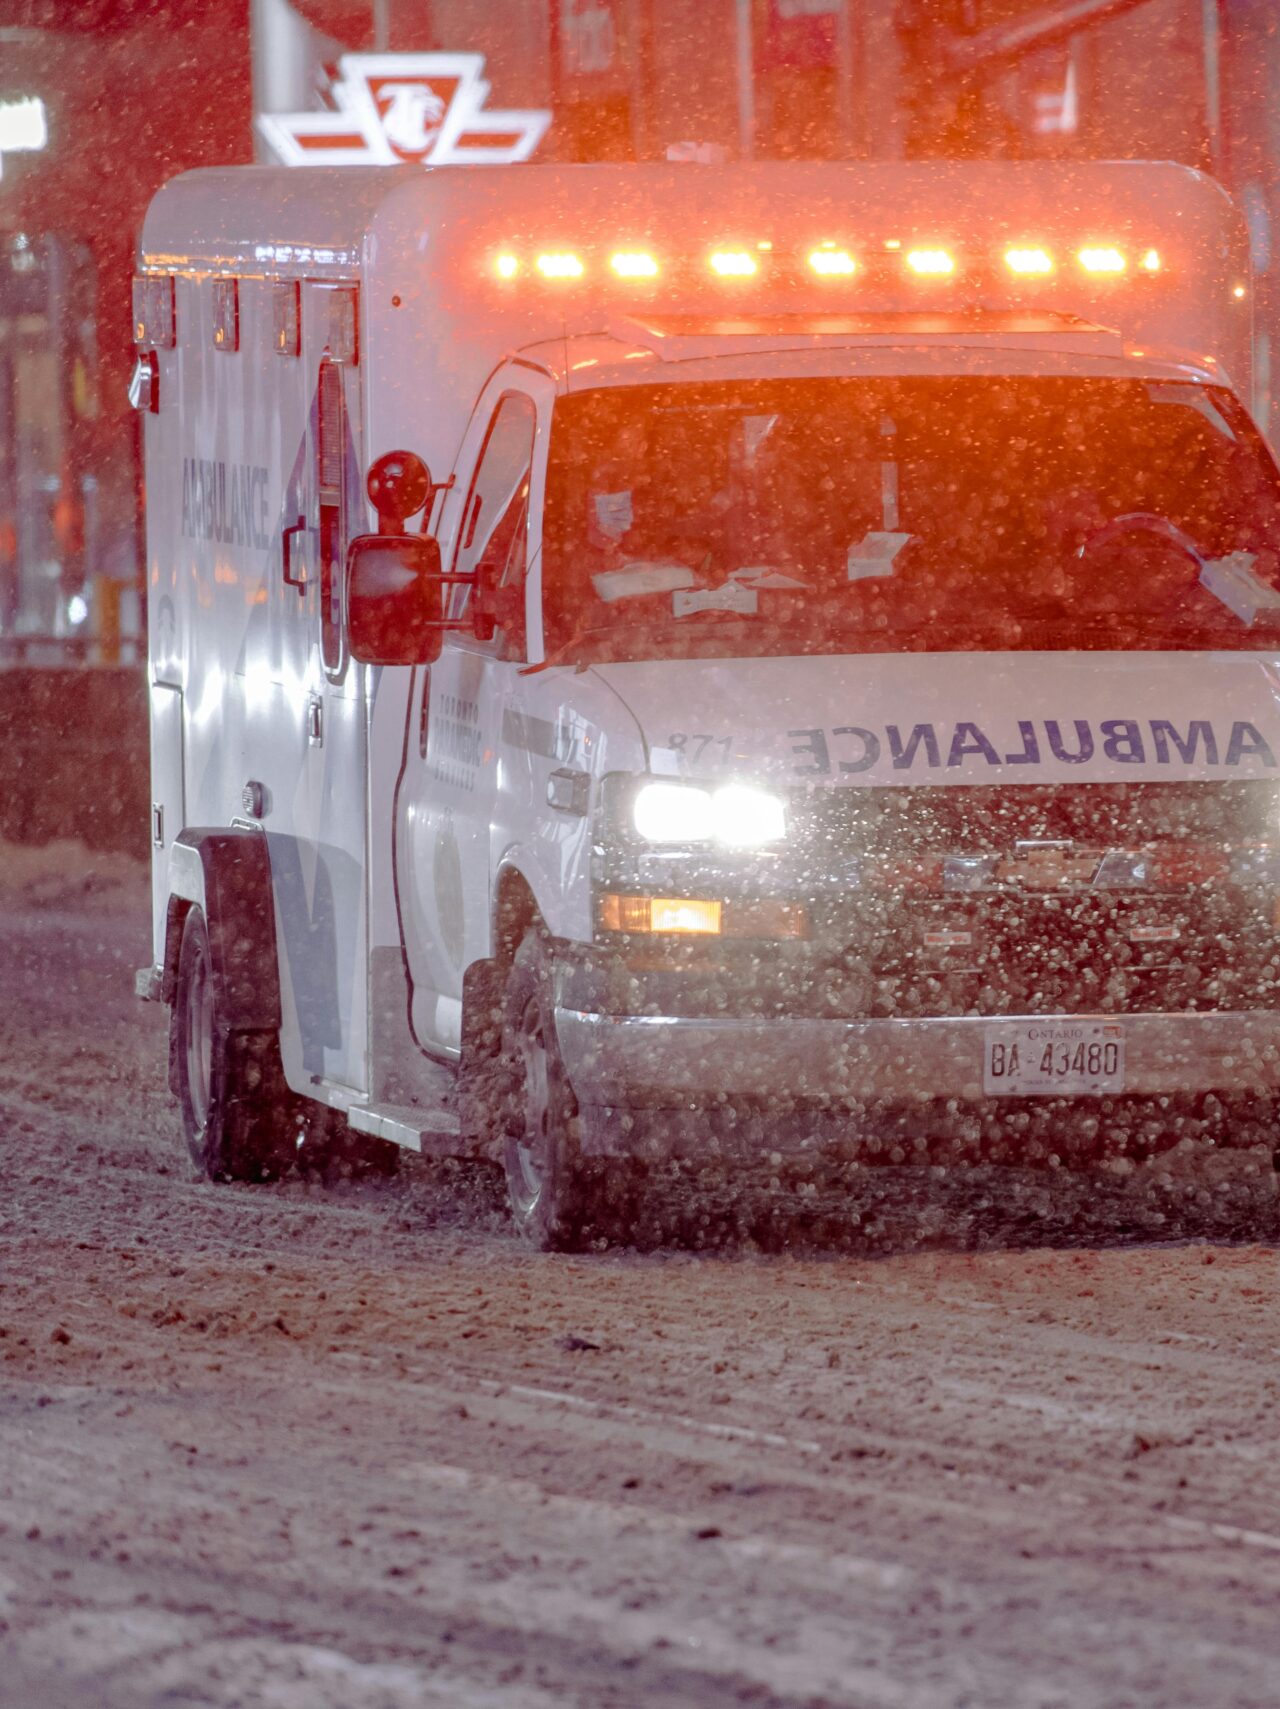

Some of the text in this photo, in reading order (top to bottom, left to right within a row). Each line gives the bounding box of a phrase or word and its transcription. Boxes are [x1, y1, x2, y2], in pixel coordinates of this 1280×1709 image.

[181, 457, 269, 551] AMBULANCE
[440, 693, 479, 725] TORONTO
[667, 732, 735, 769] 871
[1028, 1028, 1083, 1040] ONTARIO
